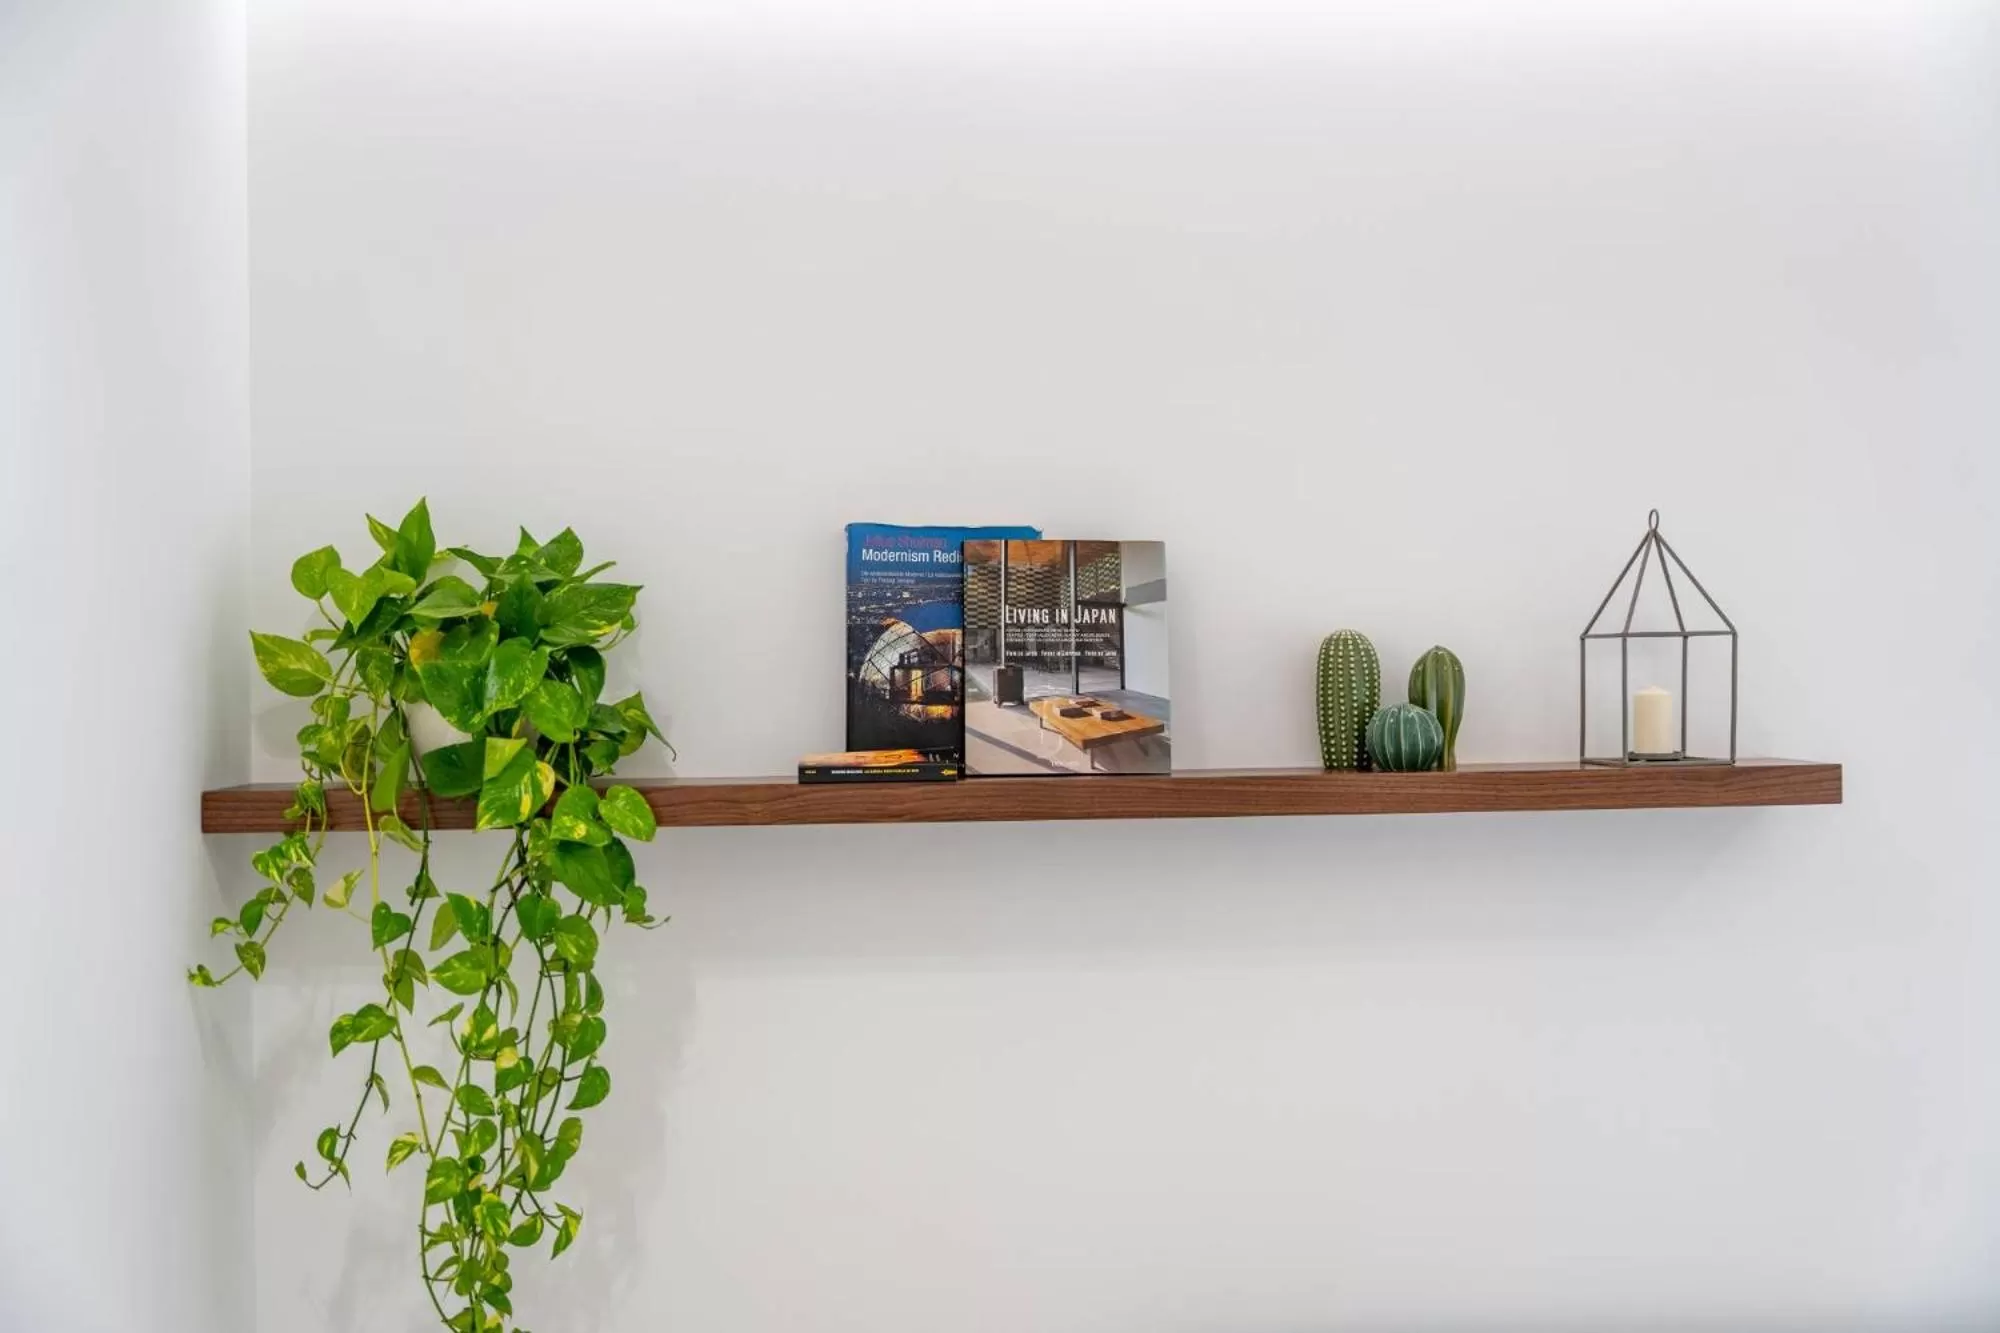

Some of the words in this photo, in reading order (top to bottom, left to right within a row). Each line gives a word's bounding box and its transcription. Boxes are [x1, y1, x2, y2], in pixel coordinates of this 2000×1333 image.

[861, 548, 930, 562] Modernism
[1005, 604, 1049, 624] LIVING
[1055, 608, 1068, 624] IN
[1074, 604, 1116, 624] JAPAN
